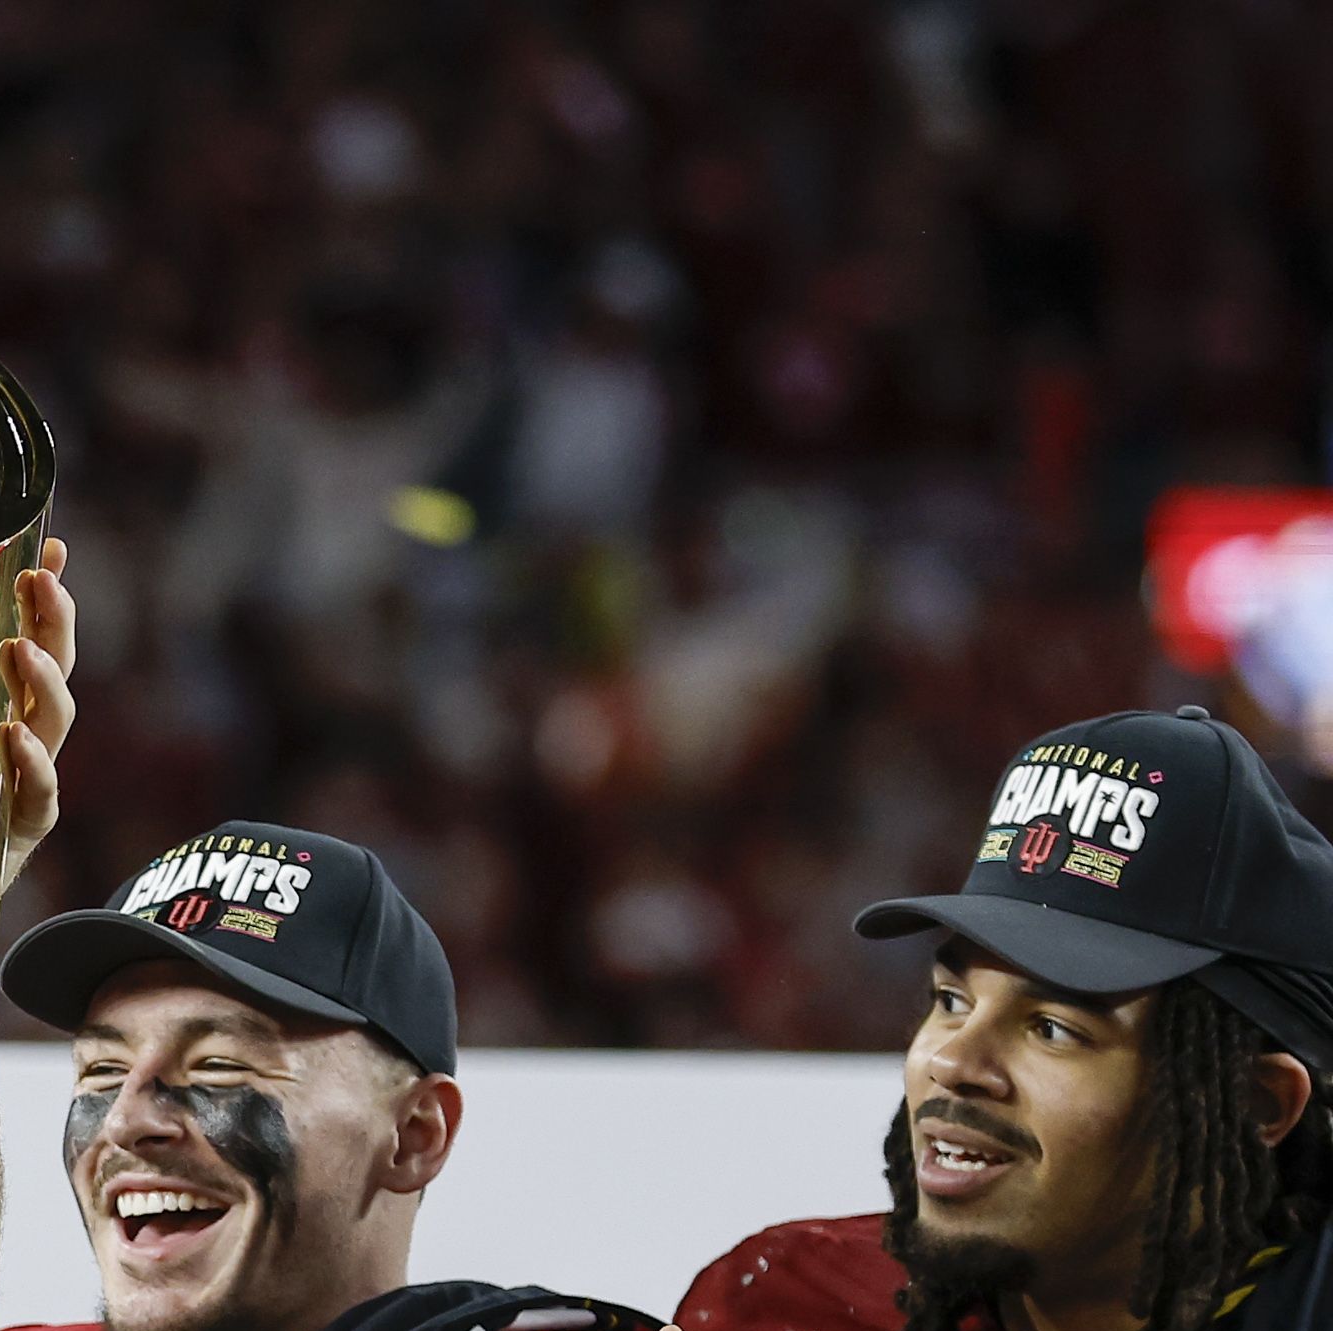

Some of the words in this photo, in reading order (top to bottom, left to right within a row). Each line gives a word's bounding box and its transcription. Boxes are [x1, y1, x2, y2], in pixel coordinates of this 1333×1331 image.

[1031, 744, 1140, 781] NATIONAL
[989, 765, 1159, 851] CHAMPS
[162, 834, 287, 862] NATIONAL
[1064, 844, 1126, 885] 25
[119, 851, 312, 915] CHAMPS
[219, 906, 279, 940] 25
